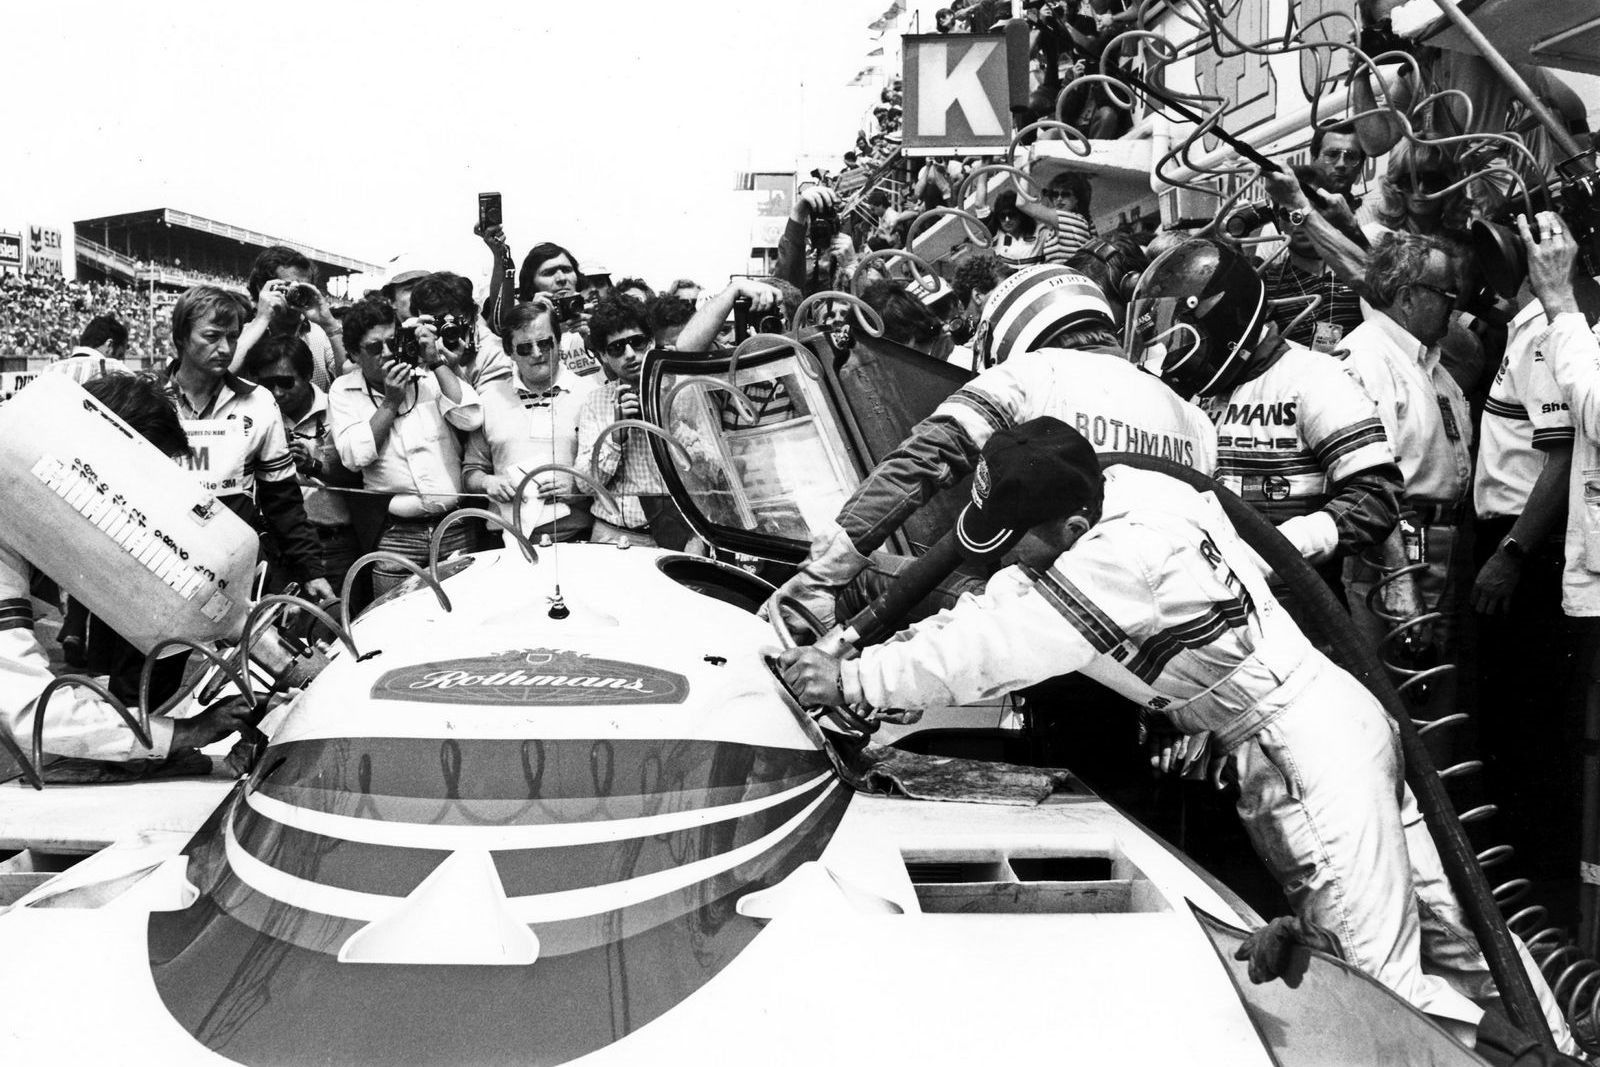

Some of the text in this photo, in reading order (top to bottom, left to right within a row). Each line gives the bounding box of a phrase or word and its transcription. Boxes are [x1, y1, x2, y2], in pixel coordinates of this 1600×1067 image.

[918, 41, 1005, 136] K
[1076, 412, 1194, 468] ROTHMANS
[1217, 436, 1298, 449] SCHE
[222, 479, 236, 489] 3M
[154, 530, 163, 539] 9
[163, 535, 174, 546] 8
[170, 543, 178, 555] 7
[179, 547, 189, 560] 6
[203, 569, 216, 582] 3
[218, 579, 230, 590] 2
[409, 669, 654, 693] Rothmans
